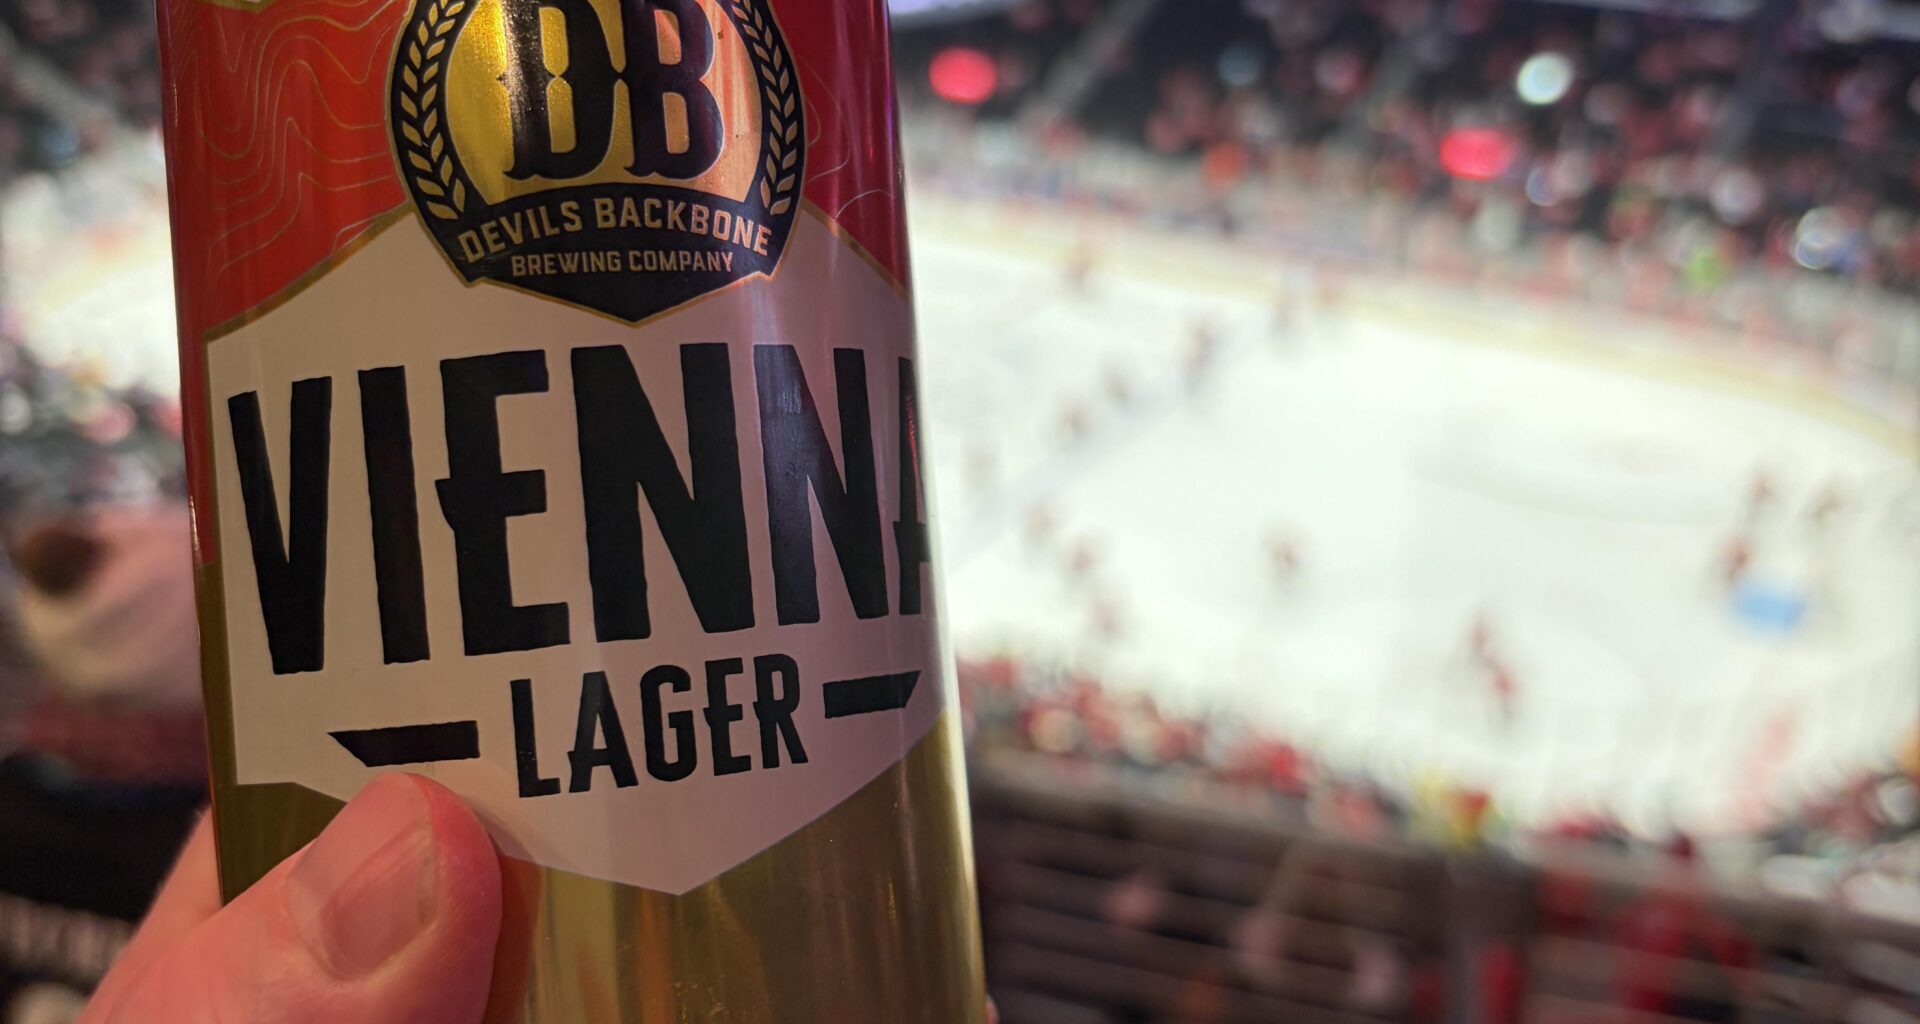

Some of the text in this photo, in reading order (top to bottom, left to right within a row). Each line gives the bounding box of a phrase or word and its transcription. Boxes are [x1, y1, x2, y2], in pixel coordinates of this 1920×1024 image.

[499, 0, 725, 180] DB
[457, 198, 773, 262] DEVILS BACKBONE
[511, 250, 735, 277] BREWING COMPANY
[510, 653, 810, 798] LAGER
